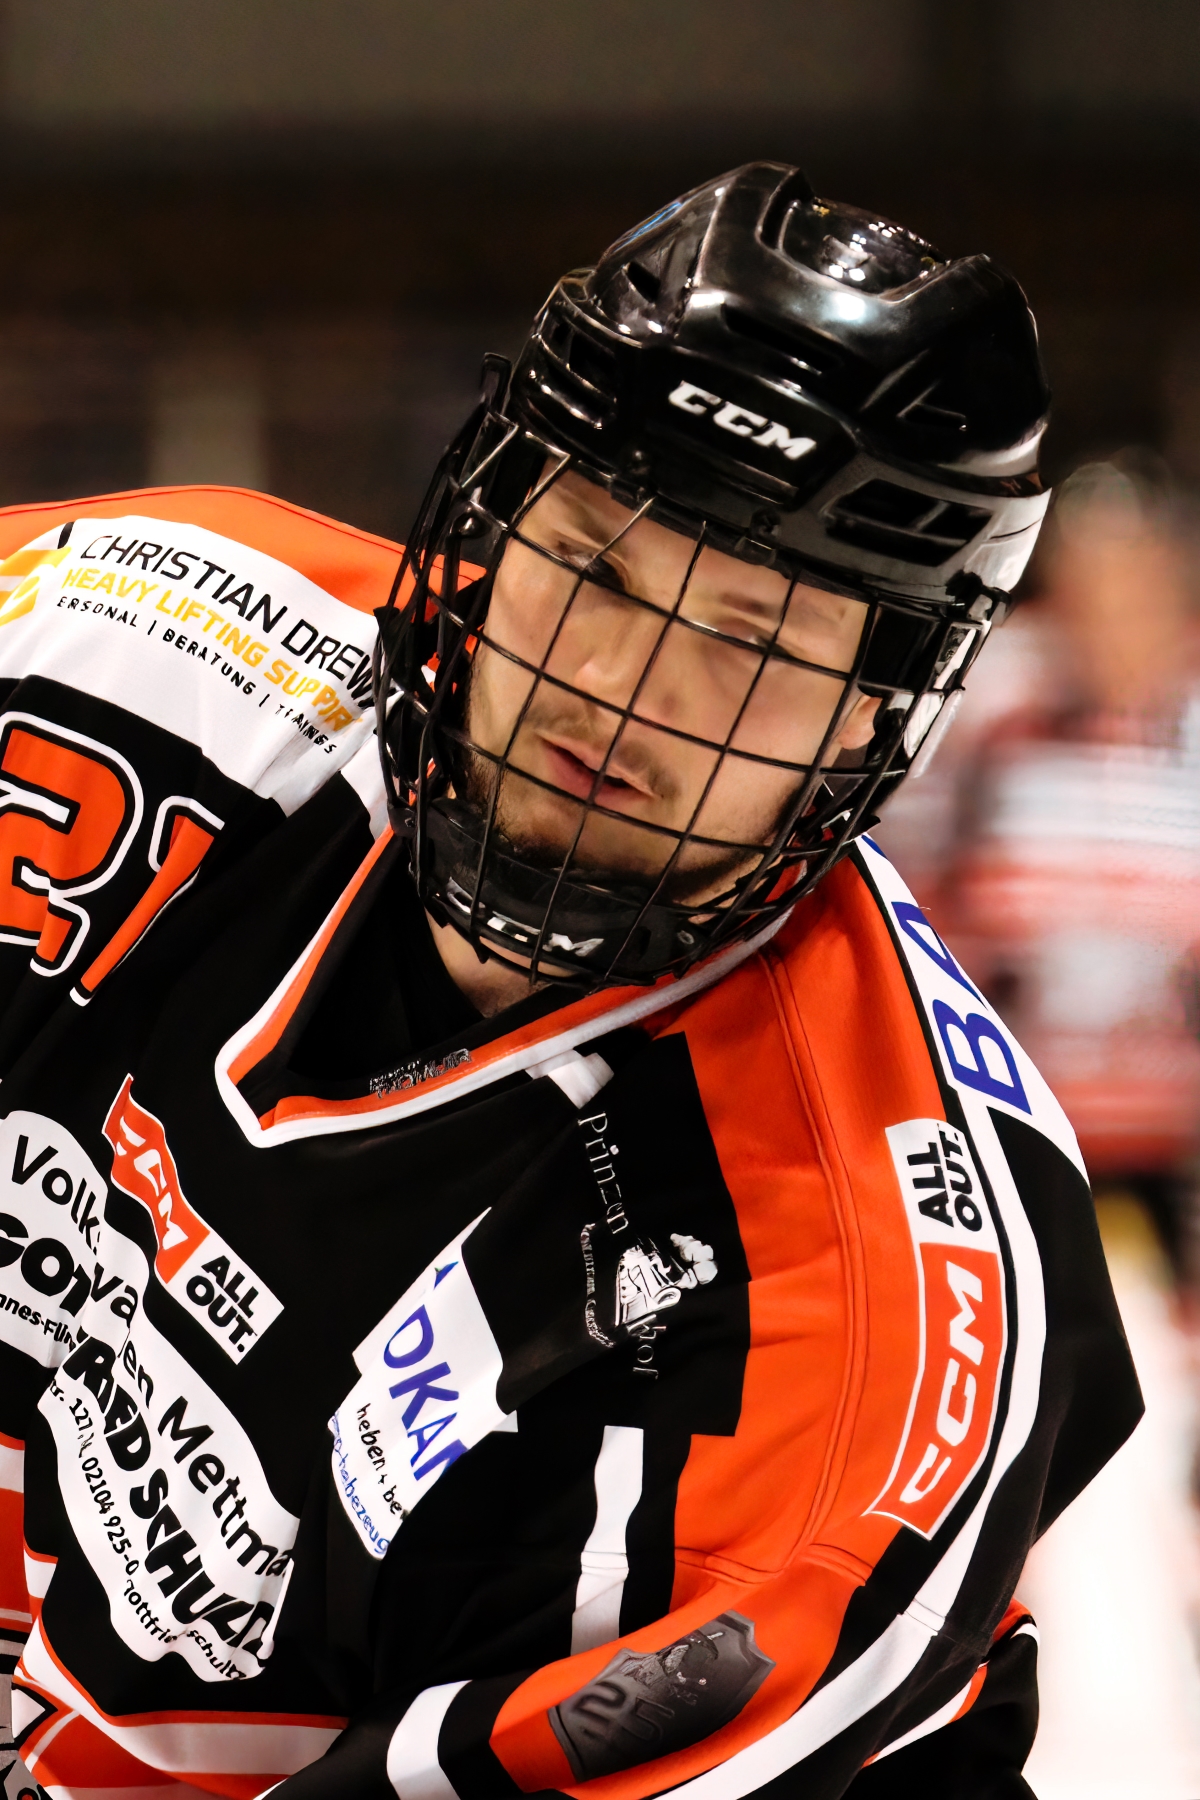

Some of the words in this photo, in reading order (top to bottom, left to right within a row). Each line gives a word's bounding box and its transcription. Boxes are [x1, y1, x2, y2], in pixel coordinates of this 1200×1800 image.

[668, 380, 817, 460] CCM
[56, 596, 138, 627] ERSONAL
[162, 628, 257, 696] BERATUNG
[61, 567, 160, 603] HEAVY
[155, 589, 270, 668] LIFTING
[80, 535, 288, 634] CHRISTIAN
[281, 618, 374, 711] DREW
[862, 834, 1033, 1116] BA
[907, 1142, 955, 1228] ALL
[186, 1275, 257, 1353] OUT.
[201, 1255, 259, 1319] ALL
[12, 1134, 101, 1256] Volk
[157, 1395, 294, 1578] Mettma
[900, 1261, 983, 1504] CCM
[357, 1403, 387, 1472] heben
[103, 1515, 140, 1576] 925-0
